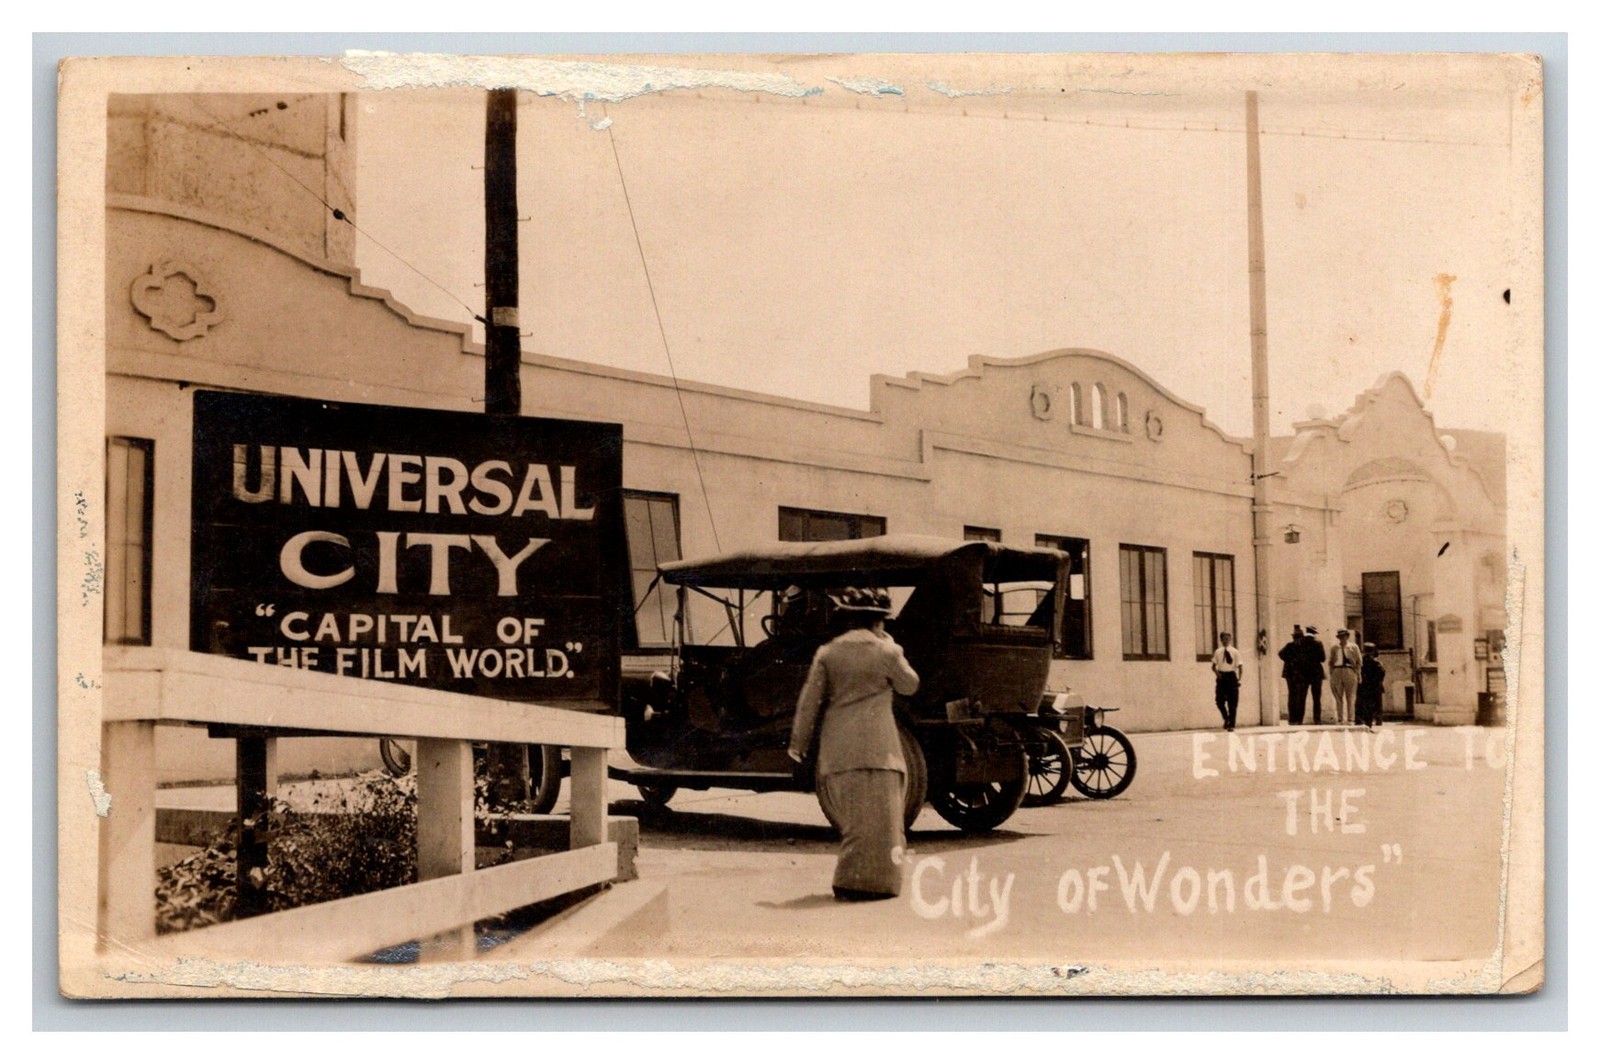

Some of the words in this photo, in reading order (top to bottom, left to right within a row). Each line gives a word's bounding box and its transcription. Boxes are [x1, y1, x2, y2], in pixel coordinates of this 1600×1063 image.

[233, 443, 596, 521] UNIVERSAL
[279, 530, 552, 597] CITY
[496, 617, 546, 645] OF
[336, 648, 428, 679] FILM
